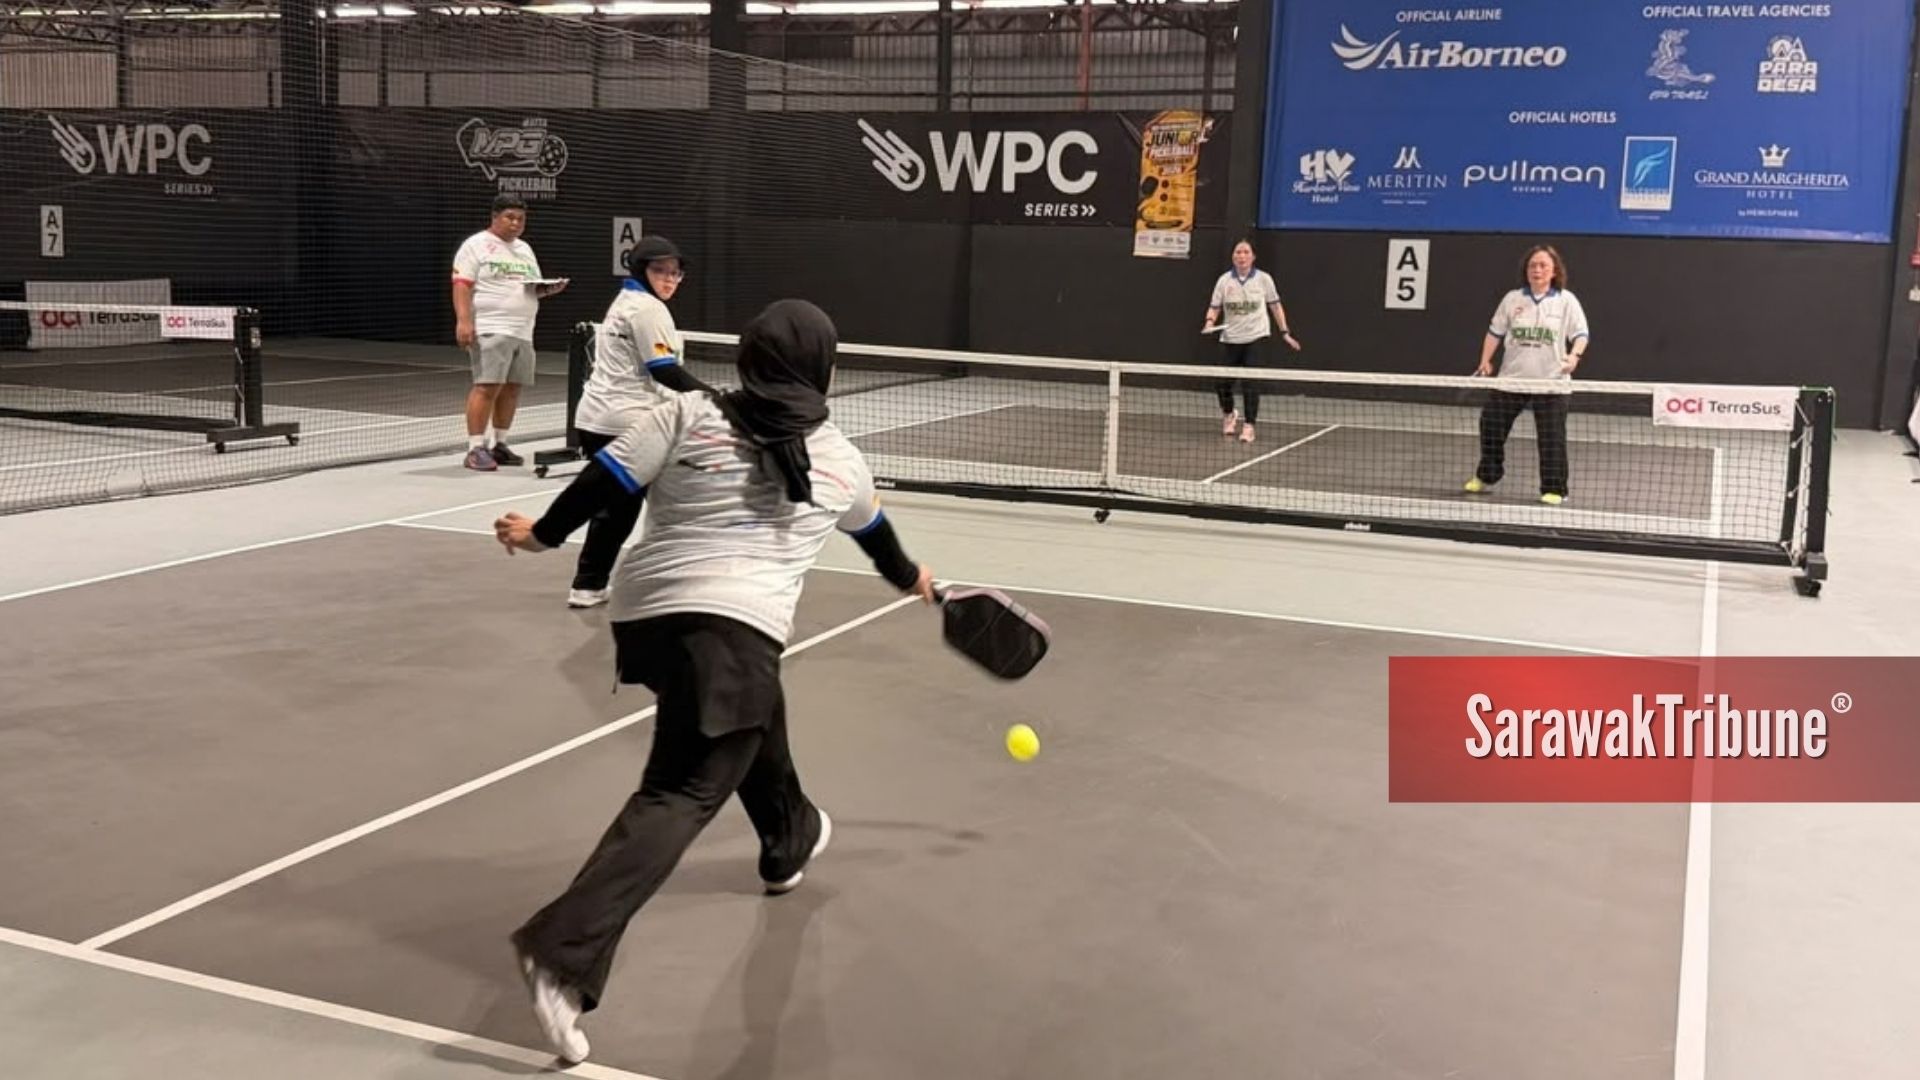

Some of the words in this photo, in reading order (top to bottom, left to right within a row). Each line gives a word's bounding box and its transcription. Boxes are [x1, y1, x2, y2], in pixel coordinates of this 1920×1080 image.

[1396, 10, 1451, 23] OFFICIAL
[1454, 9, 1502, 21] AIRLINE
[1643, 6, 1703, 18] OFFICIAL
[1706, 6, 1755, 17] TRAVEL
[1759, 5, 1831, 17] AGENCIES
[1377, 41, 1568, 70] AirBorneo
[1759, 62, 1818, 76] PARA
[1509, 111, 1566, 124] OFFICIAL
[1569, 111, 1617, 124] HOTELS
[97, 124, 213, 176] WPC
[929, 130, 1099, 194] WPC
[1367, 174, 1448, 189] MERITIN
[1464, 160, 1606, 189] pullman
[1694, 170, 1749, 184] GRAND
[1752, 171, 1849, 187] MARGHERITA
[1746, 190, 1793, 199] HOTEL
[1025, 203, 1079, 217] SERIES
[46, 210, 60, 229] A
[620, 222, 635, 244] A
[47, 233, 58, 252] 7
[1396, 246, 1419, 271] A
[1397, 277, 1416, 302] 5
[1708, 400, 1782, 415] TerraSus
